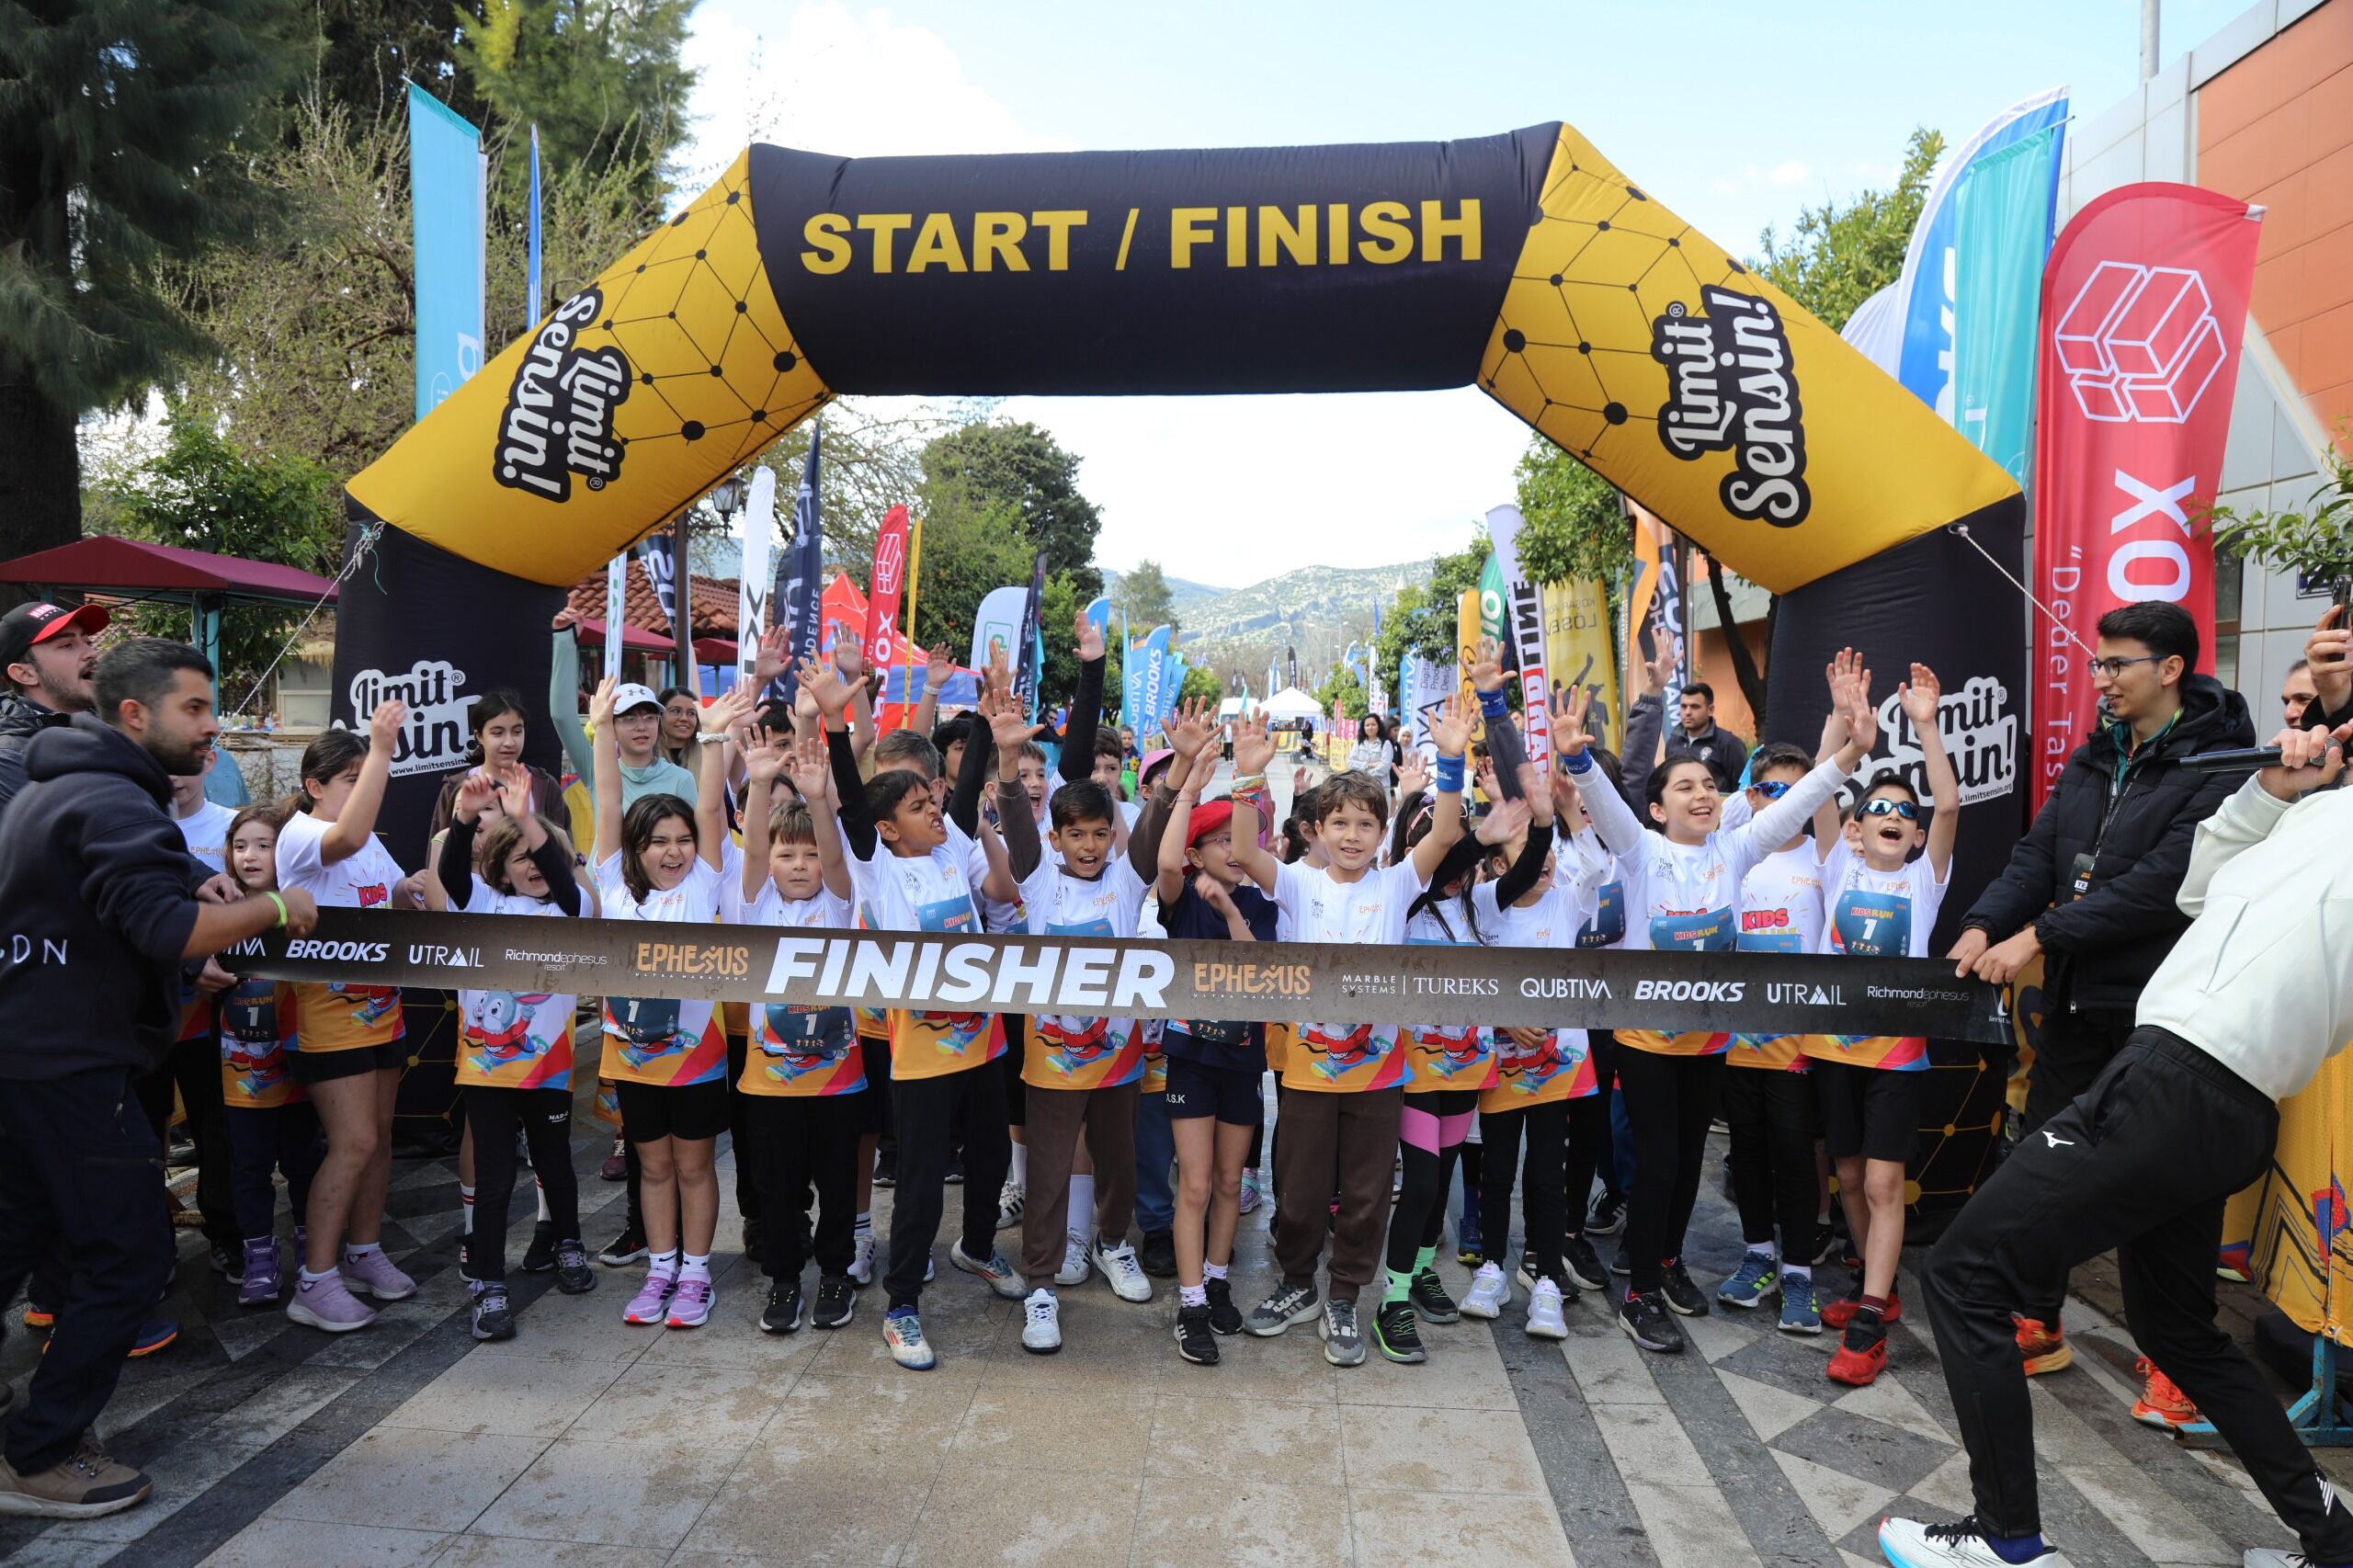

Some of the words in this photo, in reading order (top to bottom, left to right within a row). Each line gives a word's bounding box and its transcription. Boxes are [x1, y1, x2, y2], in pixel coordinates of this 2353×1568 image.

[800, 210, 1088, 275] START
[1170, 199, 1483, 268] FINISH
[1145, 648, 1162, 717] BROOKS
[358, 882, 388, 907] KIDS
[1742, 908, 1790, 931] KIDS
[1862, 918, 1878, 940] 1
[285, 939, 392, 962] BROOKS
[409, 944, 484, 968] UTRAIL
[544, 963, 566, 971] resort
[764, 937, 1176, 1008] FINISHER
[1342, 974, 1396, 984] MARBLE
[1342, 984, 1396, 994] SYSTEMS
[1413, 977, 1500, 996] TUREKS
[1520, 977, 1612, 999] QUBTIVA
[1634, 980, 1746, 1003] BROOKS
[1767, 983, 1847, 1006] UTRAIL
[246, 1006, 259, 1027] 1
[628, 1001, 640, 1022] 1
[804, 1014, 818, 1036] 1
